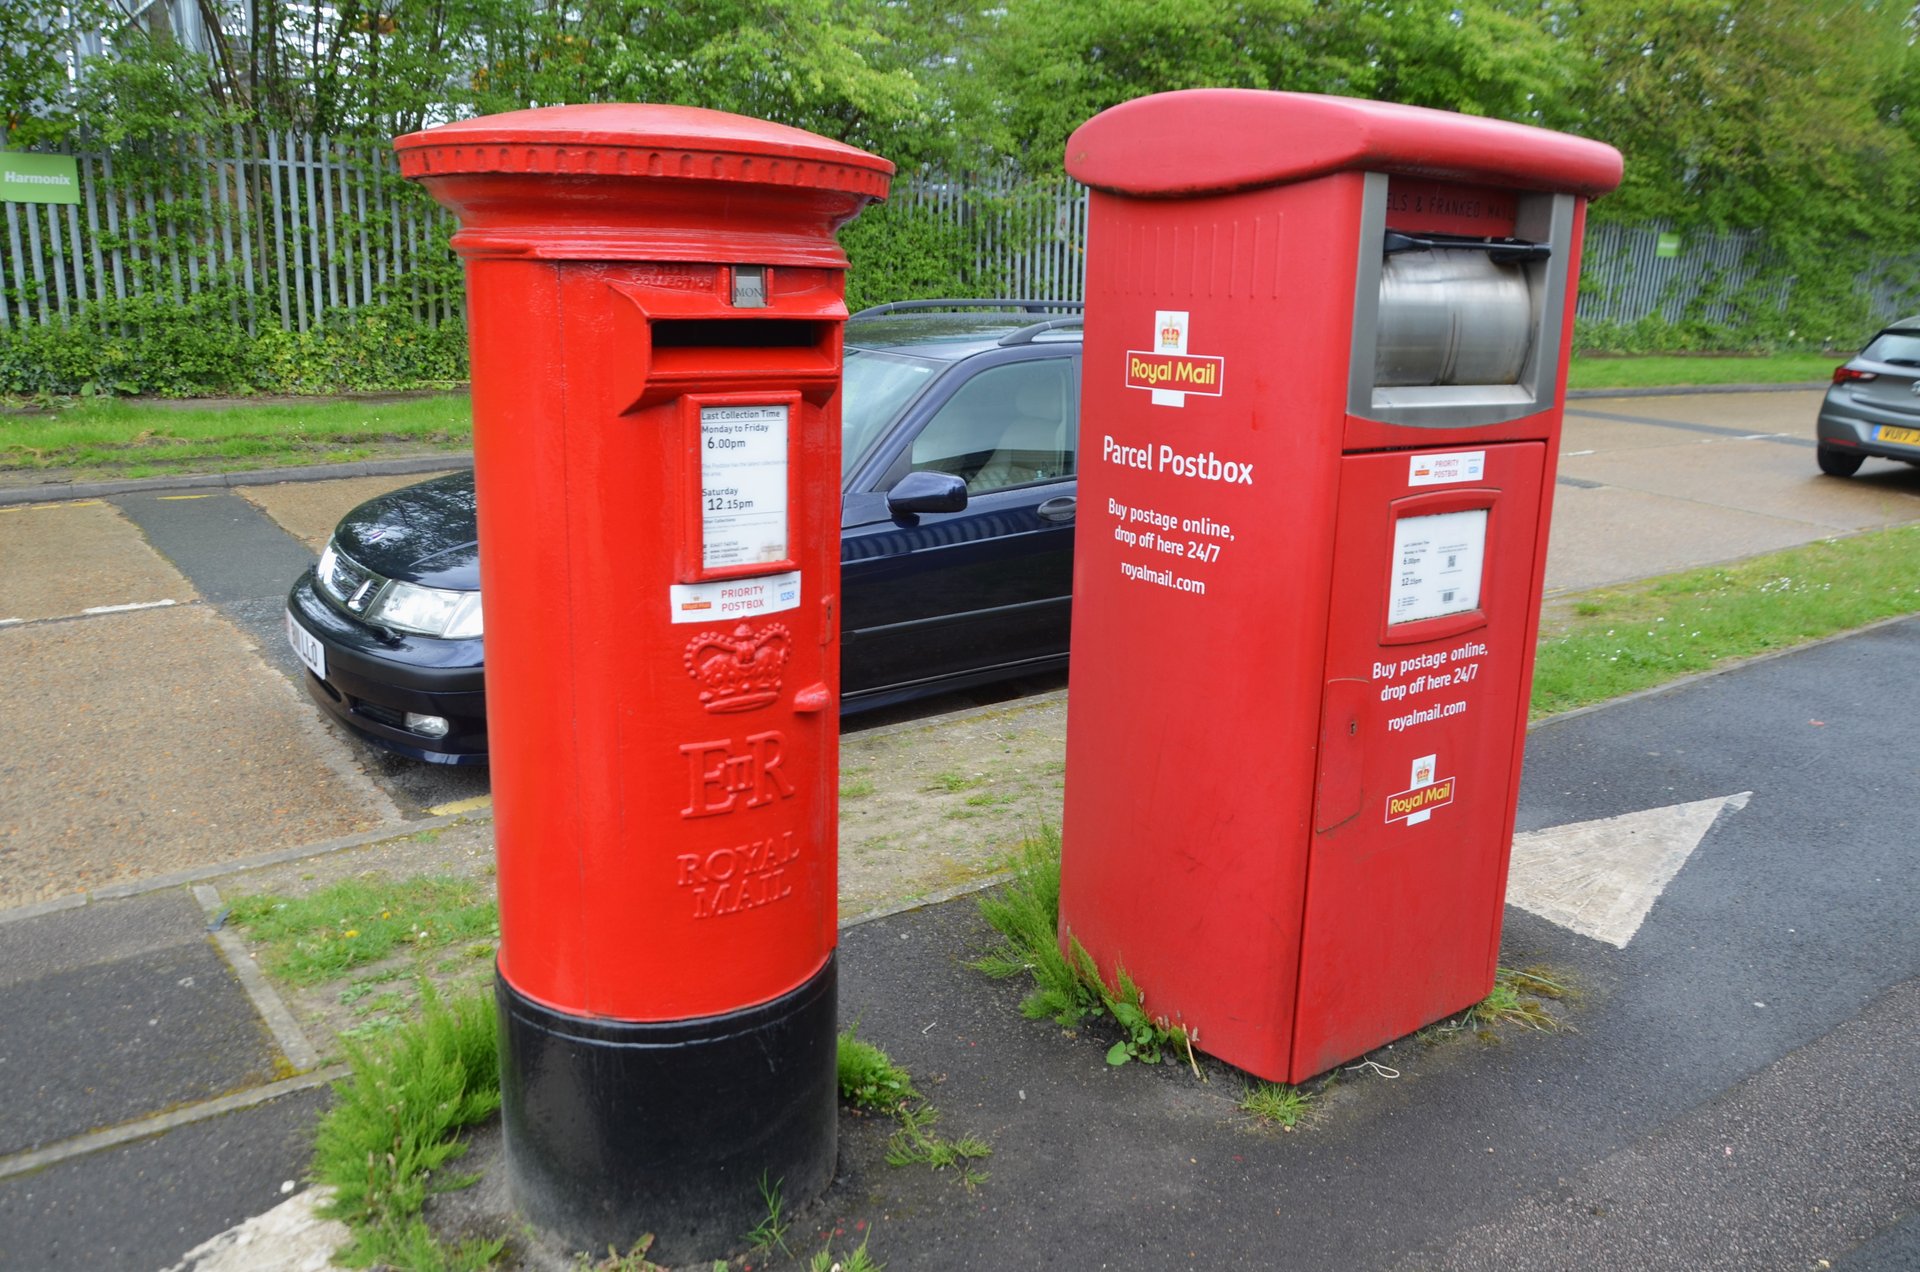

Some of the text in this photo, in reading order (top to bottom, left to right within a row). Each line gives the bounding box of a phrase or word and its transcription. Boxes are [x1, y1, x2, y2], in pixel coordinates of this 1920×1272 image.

[5, 171, 71, 185] Harmonix
[735, 287, 763, 298] MON
[1131, 357, 1216, 385] Royal Mail
[701, 409, 780, 420] Last Collection Time
[702, 425, 733, 434] Monday
[744, 424, 769, 433] Friday
[707, 436, 746, 450] 6.00pm
[1103, 434, 1253, 485] Parcel Postbox
[702, 487, 738, 497] Saturday
[707, 497, 754, 511] 12.15pm
[1108, 497, 1235, 541] Buy postage online,
[1114, 525, 1221, 563] drop off here 24/7
[721, 585, 765, 598] PRIORITY
[1121, 561, 1205, 595] royalmail.com
[721, 598, 765, 612] POSTBOX
[1372, 642, 1488, 679] Buy postage online,
[1380, 664, 1477, 701] drop off here 24/7
[1388, 702, 1465, 731] royalmail.com
[1390, 784, 1450, 814] Royal Mail
[677, 831, 800, 885] ROYAL
[693, 868, 792, 920] MAIL
